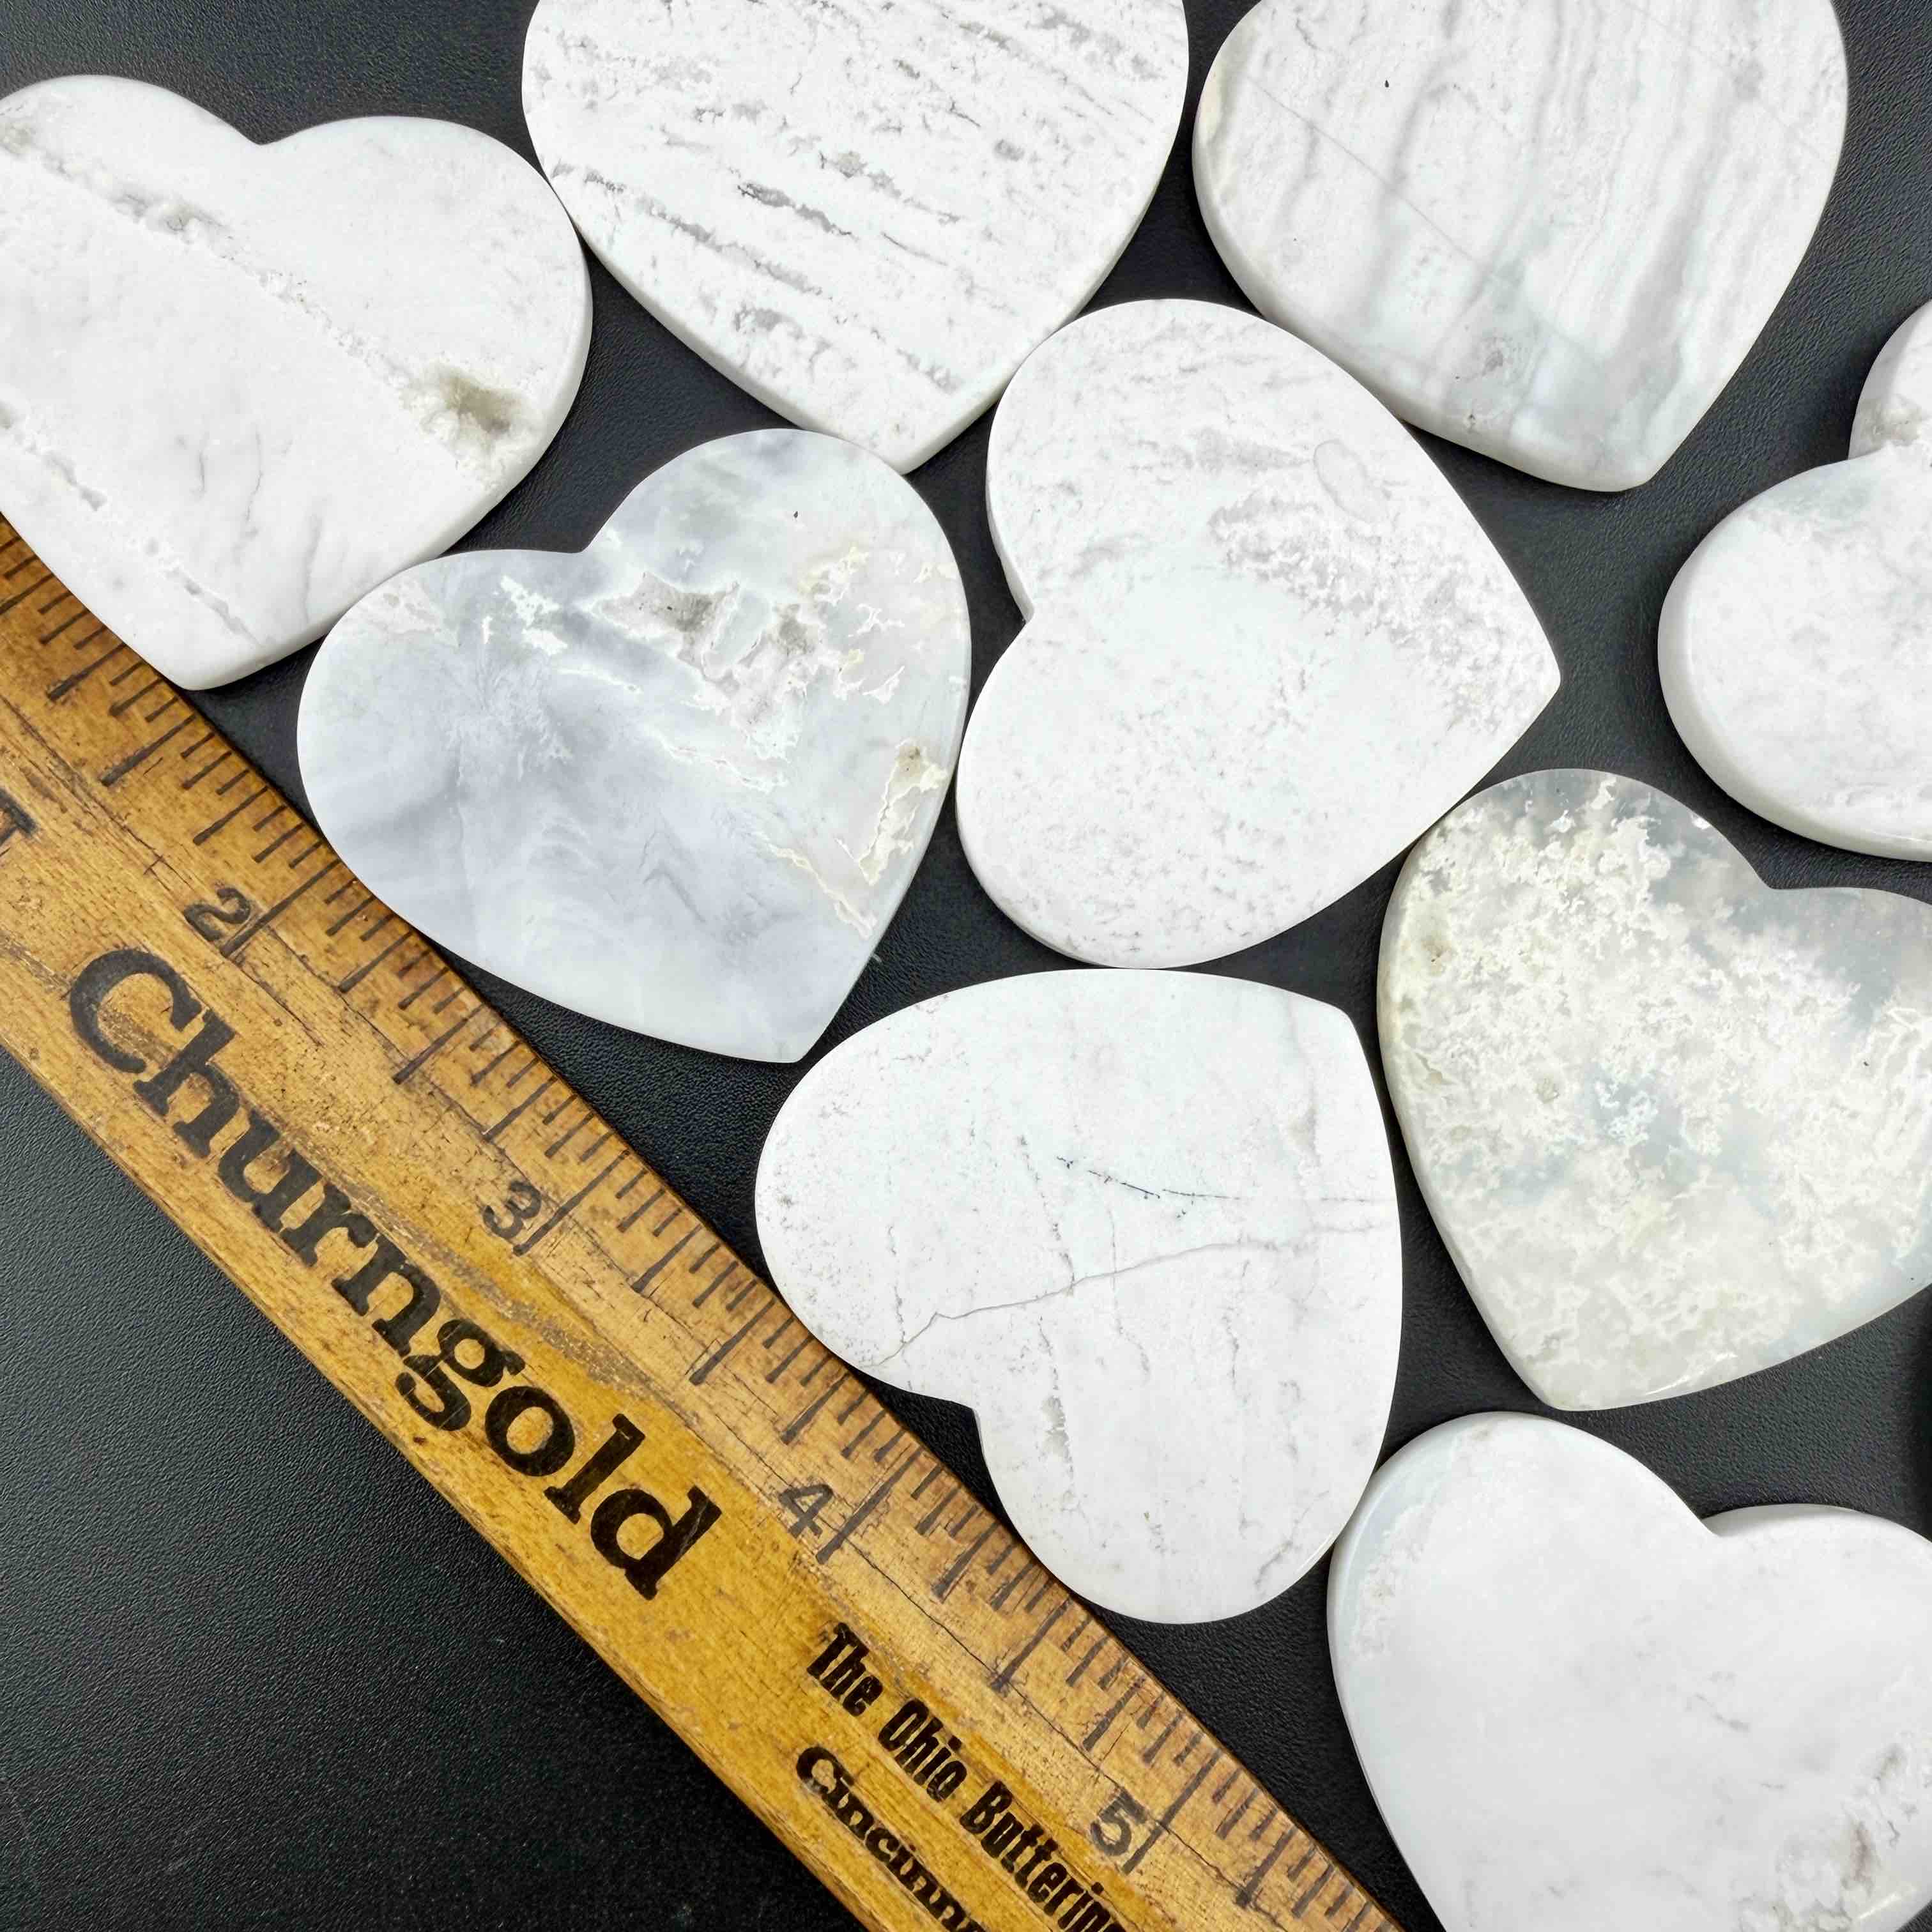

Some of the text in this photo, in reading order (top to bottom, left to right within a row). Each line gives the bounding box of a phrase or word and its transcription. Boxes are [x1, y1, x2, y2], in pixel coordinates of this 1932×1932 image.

[184, 887, 251, 942] 2
[483, 1181, 542, 1239] 3
[69, 948, 723, 1600] Churngold
[778, 1483, 834, 1539] 4
[806, 1621, 1126, 1932] The Ohio Butterin
[796, 1746, 986, 1932] Cincinn
[1090, 1786, 1147, 1856] 5
